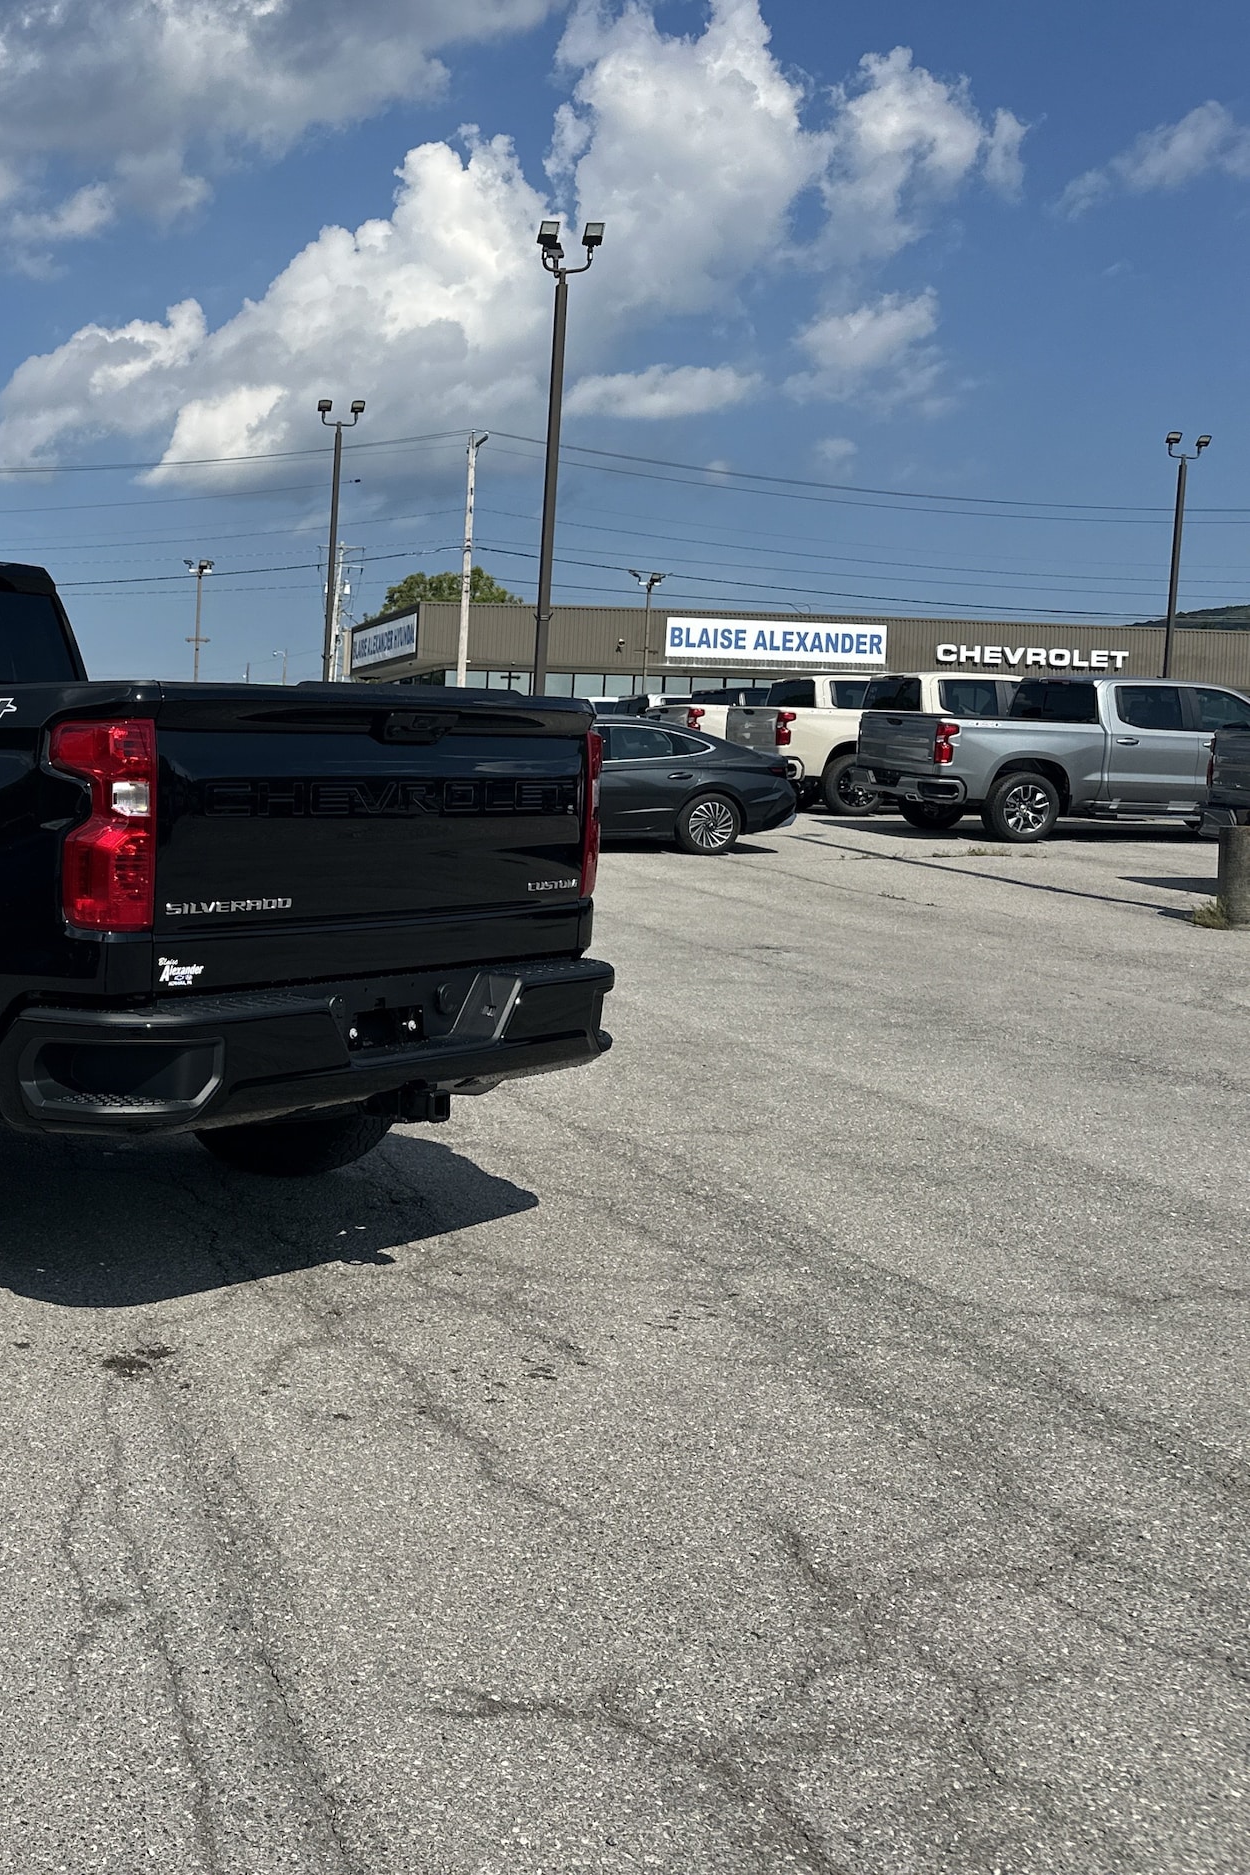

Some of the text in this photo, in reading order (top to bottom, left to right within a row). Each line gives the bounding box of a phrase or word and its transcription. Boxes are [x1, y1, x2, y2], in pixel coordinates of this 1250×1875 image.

[669, 627, 883, 655] BLAISE ALEXANDER
[936, 643, 1130, 669] CHEVROLET
[204, 780, 575, 817] CHEVROLET
[527, 878, 579, 892] CUSTOM
[165, 897, 292, 916] SILVERADO
[159, 964, 204, 982] Alexander
